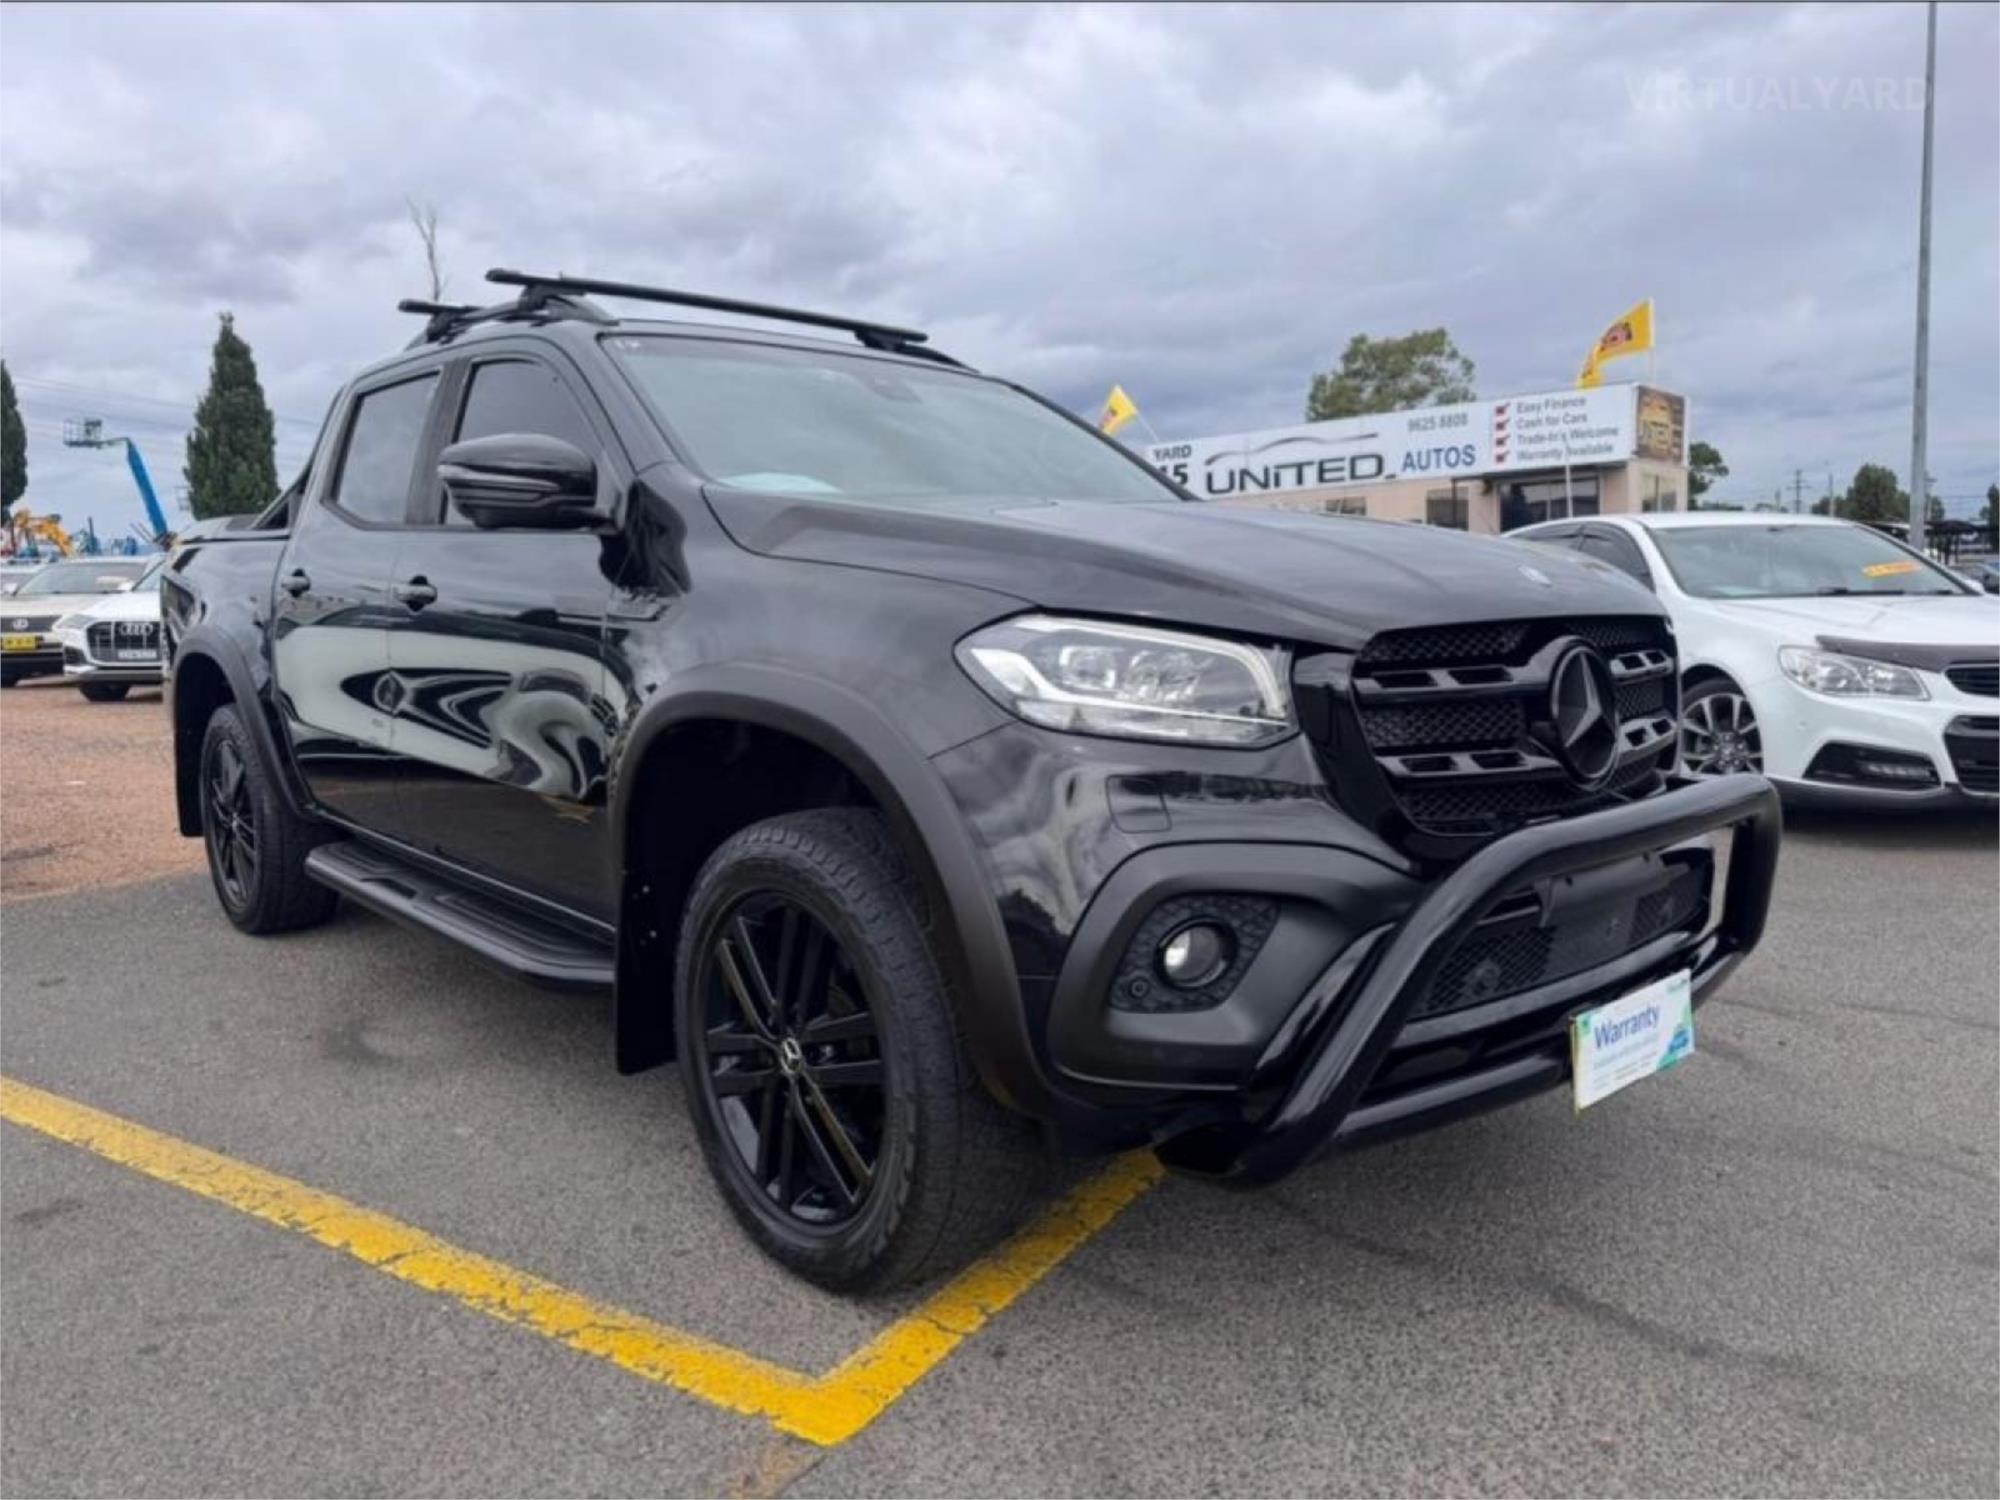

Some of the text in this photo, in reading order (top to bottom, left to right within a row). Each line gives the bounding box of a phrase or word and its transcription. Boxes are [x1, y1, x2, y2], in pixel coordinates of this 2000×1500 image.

[1517, 397, 1586, 415] Easy Finance
[1516, 411, 1587, 429] Cash for Cars
[1570, 426, 1619, 439] Welcome
[1153, 444, 1192, 460] YARD
[1402, 444, 1476, 472] AUTOS
[1517, 447, 1563, 461] Warranty
[1594, 1006, 1659, 1049] Warranty
